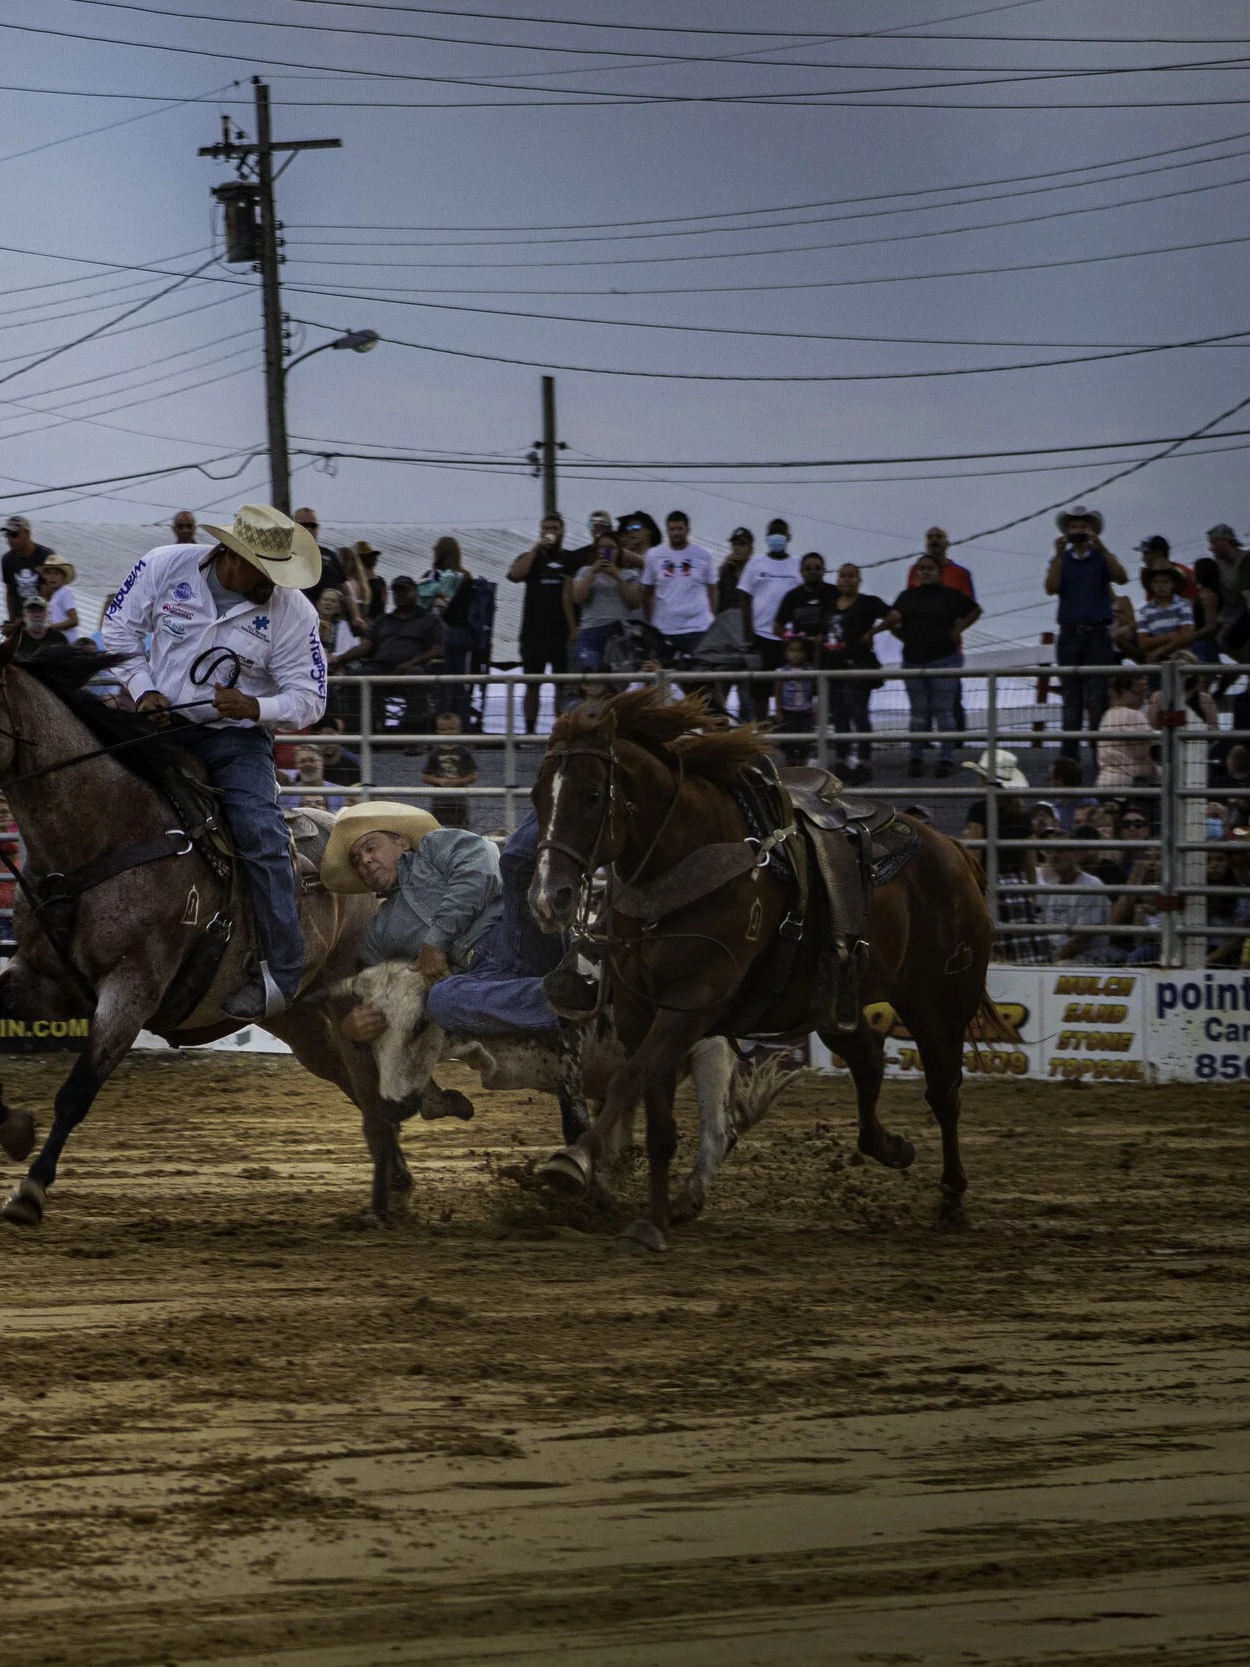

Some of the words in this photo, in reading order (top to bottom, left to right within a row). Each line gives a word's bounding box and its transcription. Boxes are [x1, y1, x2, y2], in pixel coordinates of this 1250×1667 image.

[1054, 975, 1136, 996] MULCH
[1062, 1003, 1128, 1023] SAND
[1056, 1030, 1134, 1052] STONE
[1048, 1058, 1144, 1080] TOPSOIL
[1195, 1054, 1250, 1080] 85
